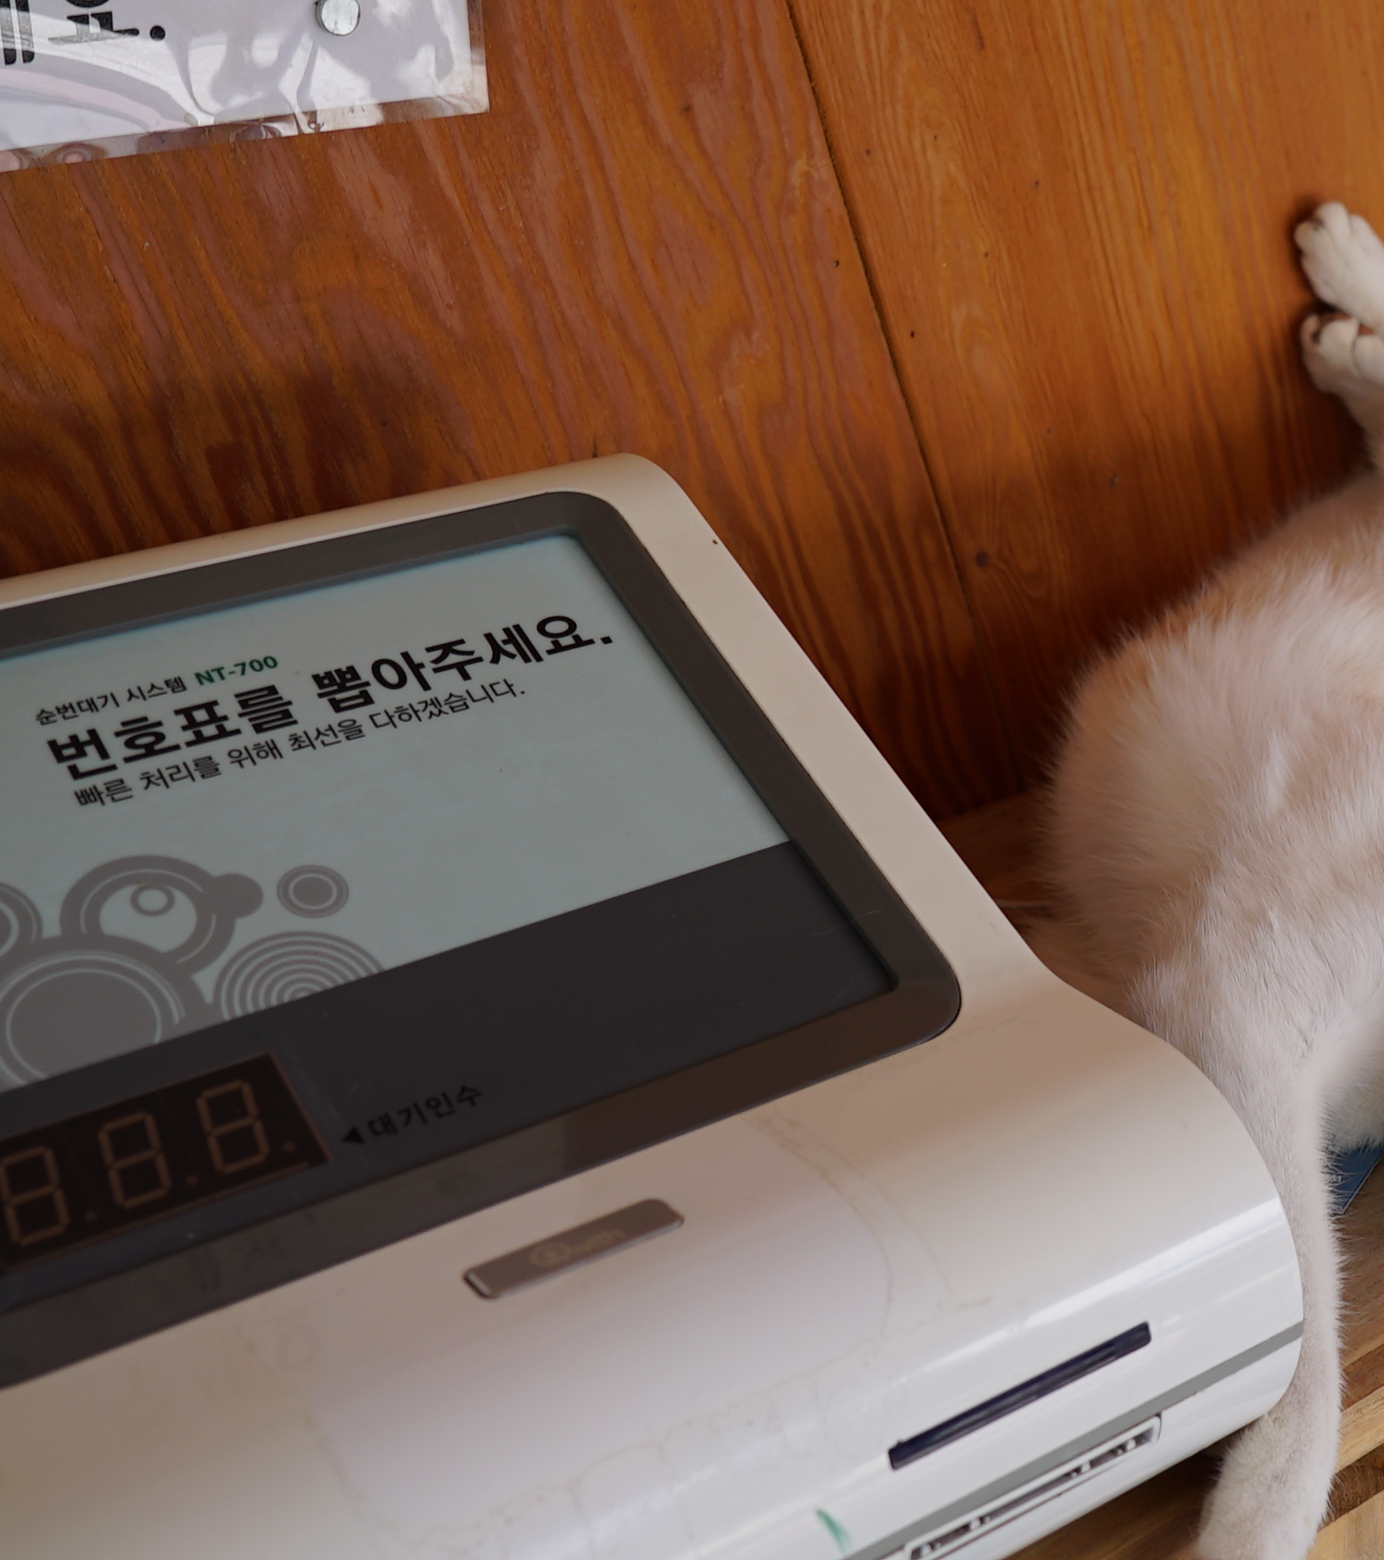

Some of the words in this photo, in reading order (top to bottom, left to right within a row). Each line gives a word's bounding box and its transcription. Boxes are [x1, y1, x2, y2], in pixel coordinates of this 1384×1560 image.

[34, 693, 120, 726] 순번대기
[126, 675, 188, 704] 시스템
[194, 655, 279, 687] NT-700
[46, 684, 299, 781] 번호표를
[311, 614, 613, 713] 뽑아주세요.
[74, 780, 134, 808] 빠른
[138, 757, 223, 793] 처리를
[227, 738, 284, 770] 위해
[288, 718, 366, 753] 최선을
[369, 678, 526, 727] 다하겠습니다.
[366, 1083, 483, 1138] 대기인수
